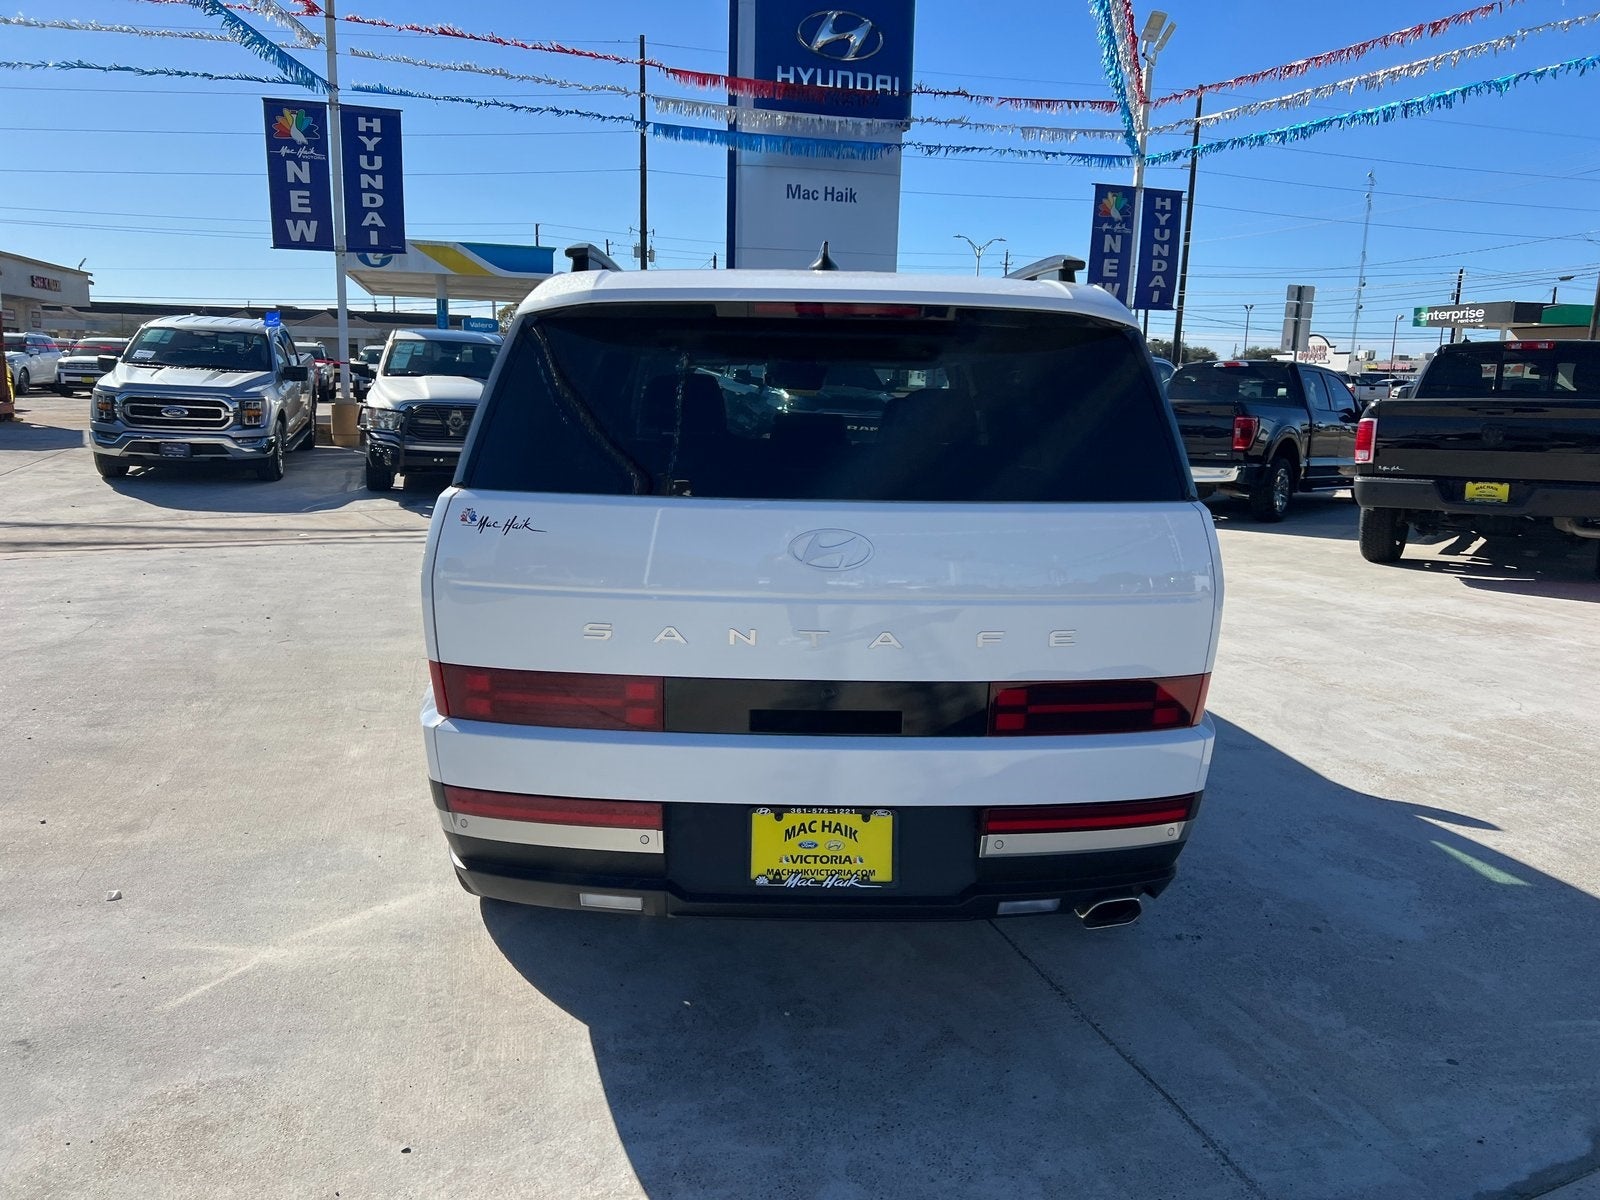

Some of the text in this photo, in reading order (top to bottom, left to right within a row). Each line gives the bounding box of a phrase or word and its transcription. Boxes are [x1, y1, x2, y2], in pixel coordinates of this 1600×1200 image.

[776, 65, 900, 96] HYUNDAI
[357, 116, 386, 246] HYUNDAI
[285, 160, 318, 243] NEW
[786, 183, 858, 203] Mac Haik
[1148, 197, 1172, 303] HYUNDAI
[1415, 306, 1485, 323] enterprise
[469, 321, 493, 330] Valero
[477, 515, 546, 536] Mac Haik
[583, 622, 1078, 649] SANTA FE
[790, 807, 856, 815] 361-576-1221
[783, 820, 859, 843] MAC HAIK
[799, 841, 817, 849] Ford
[790, 855, 853, 864] VICTORIA
[766, 868, 876, 877] MACHAIKVICTORIACOM
[784, 873, 871, 888] Mac Haik
